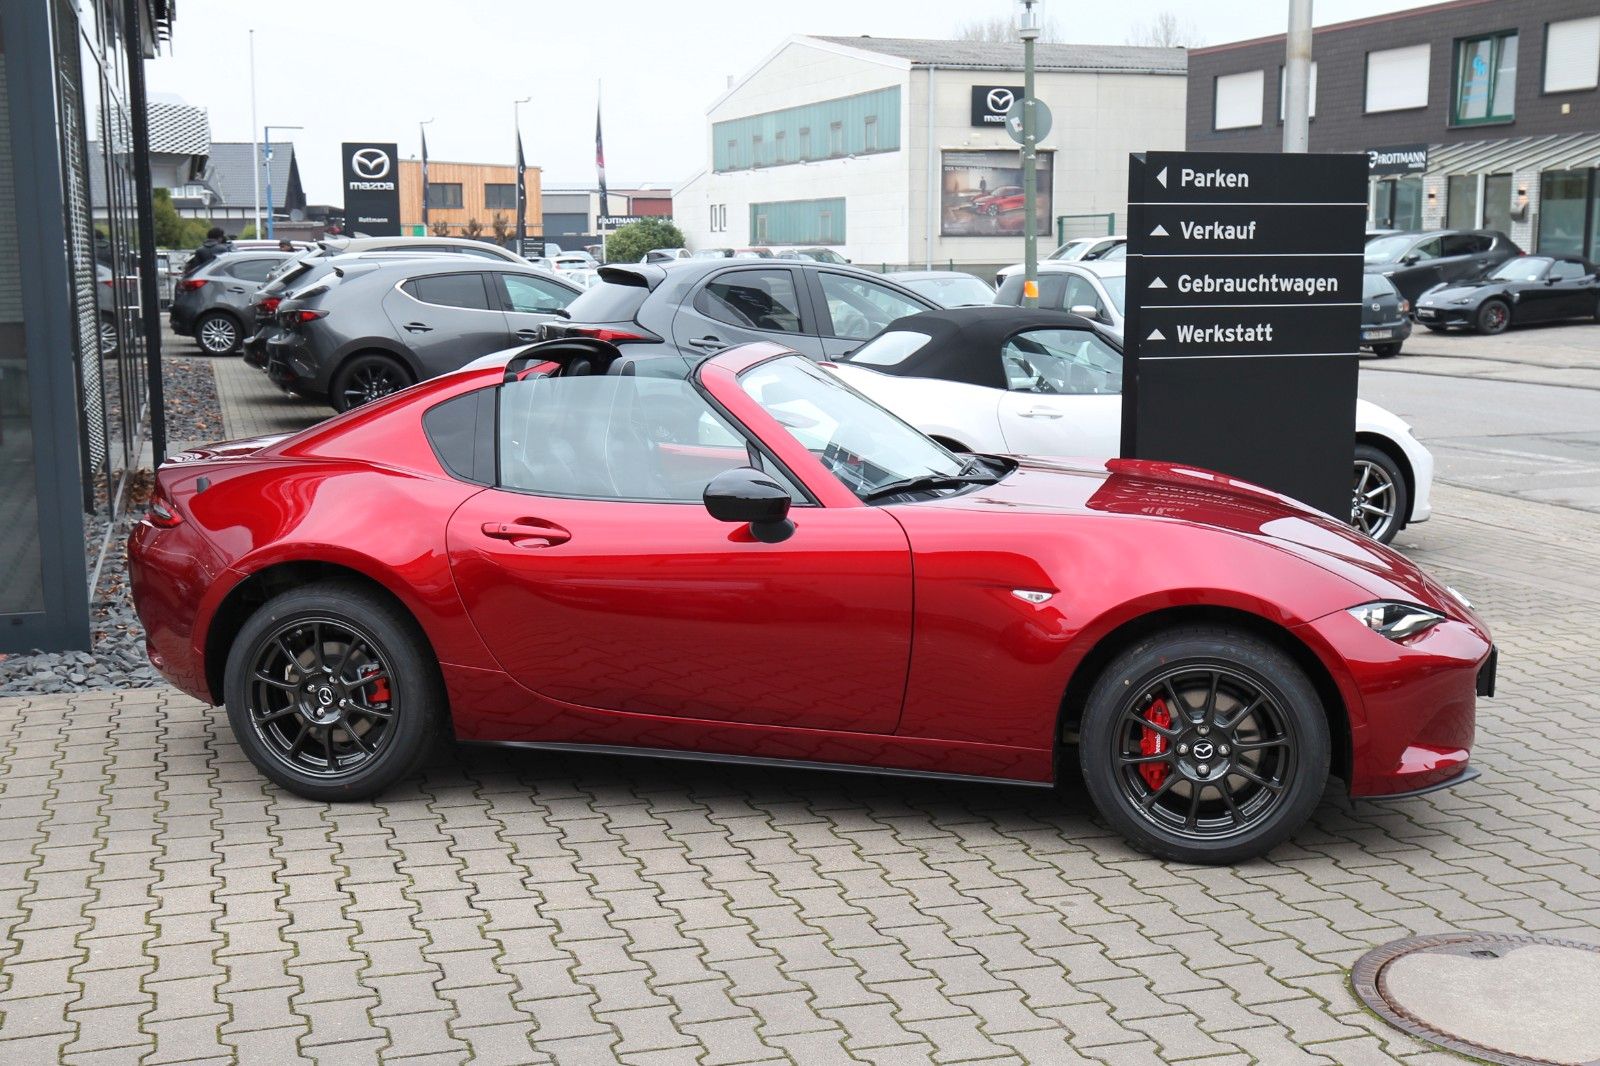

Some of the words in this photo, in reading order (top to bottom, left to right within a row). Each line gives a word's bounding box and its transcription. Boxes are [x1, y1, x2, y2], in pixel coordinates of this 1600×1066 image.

[984, 115, 1007, 123] maz
[1180, 168, 1250, 188] Parken
[1180, 220, 1257, 240] Verkauf
[1177, 273, 1339, 296] Gebrauchtwagen
[1176, 323, 1274, 343] Werkstatt
